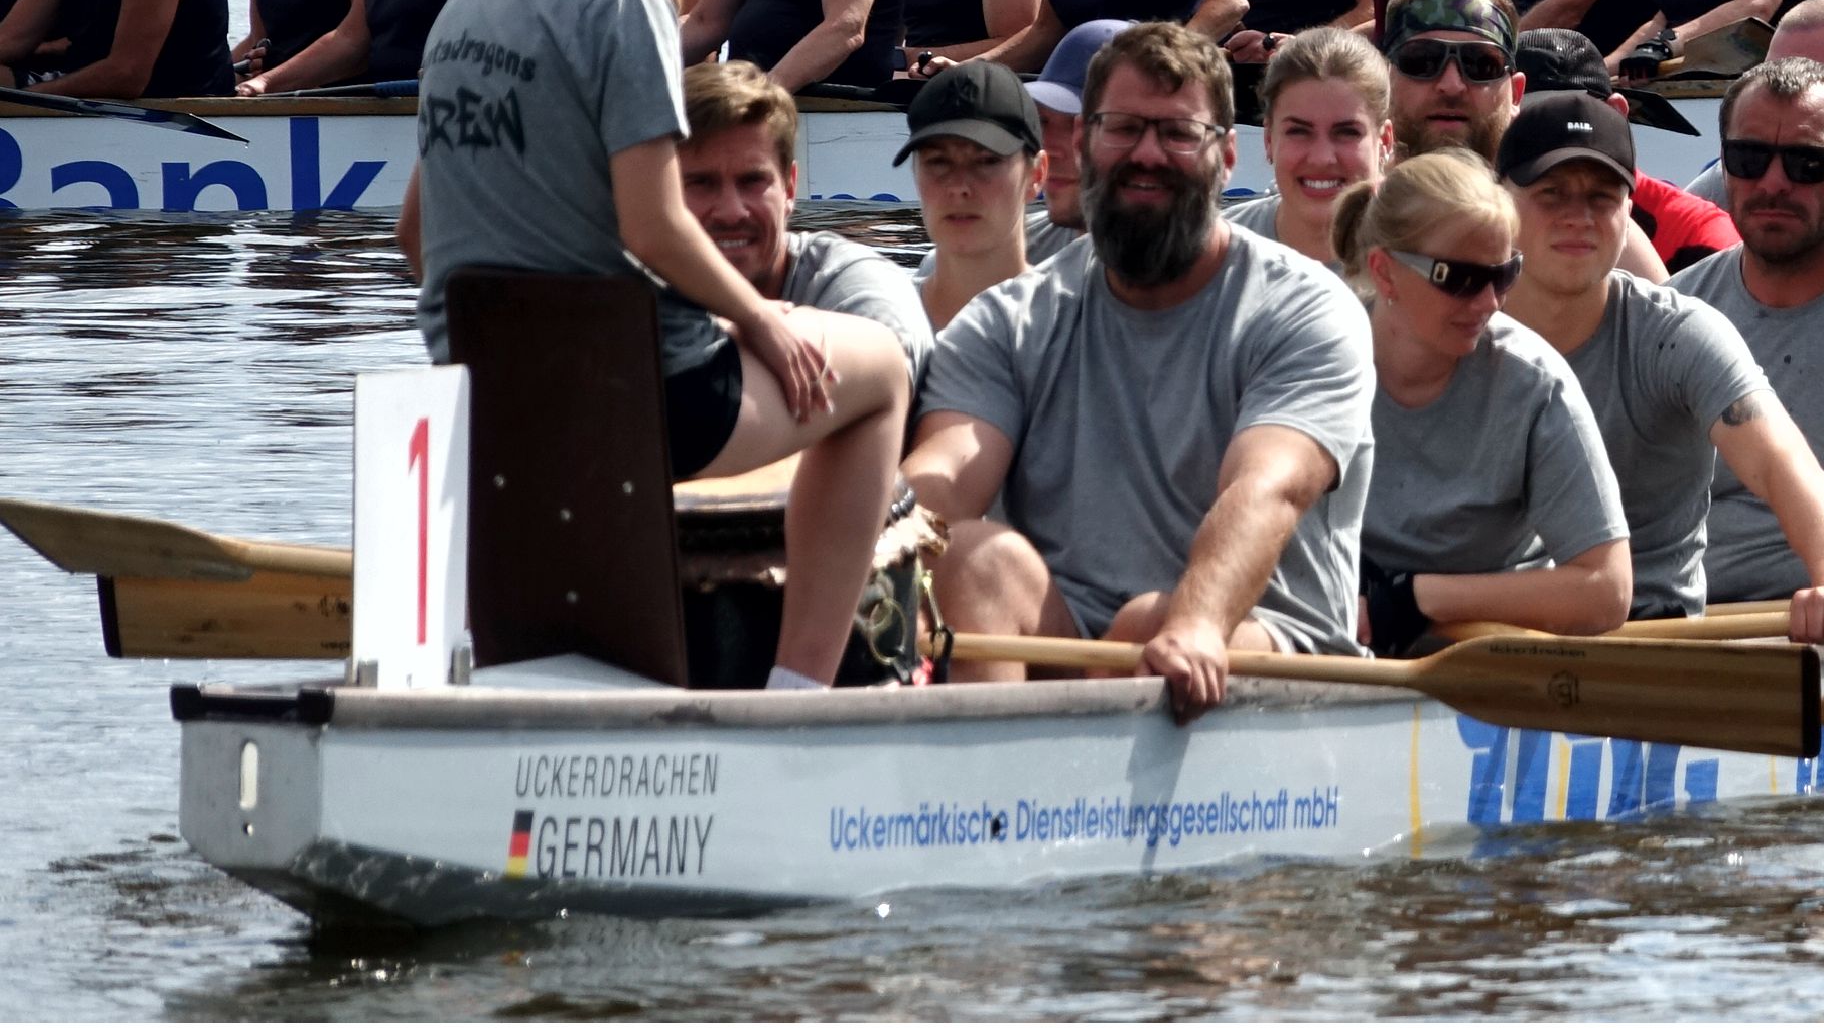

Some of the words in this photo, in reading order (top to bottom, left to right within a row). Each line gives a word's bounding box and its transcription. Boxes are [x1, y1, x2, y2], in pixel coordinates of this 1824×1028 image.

[408, 418, 429, 646] 1
[515, 753, 719, 799] UCKERDRACHEN
[536, 814, 714, 881] GERMANY
[829, 799, 1009, 852] Uckermärkische
[1015, 787, 1289, 848] Dienstleistungsgesellschaft
[1292, 785, 1339, 830] mbH
